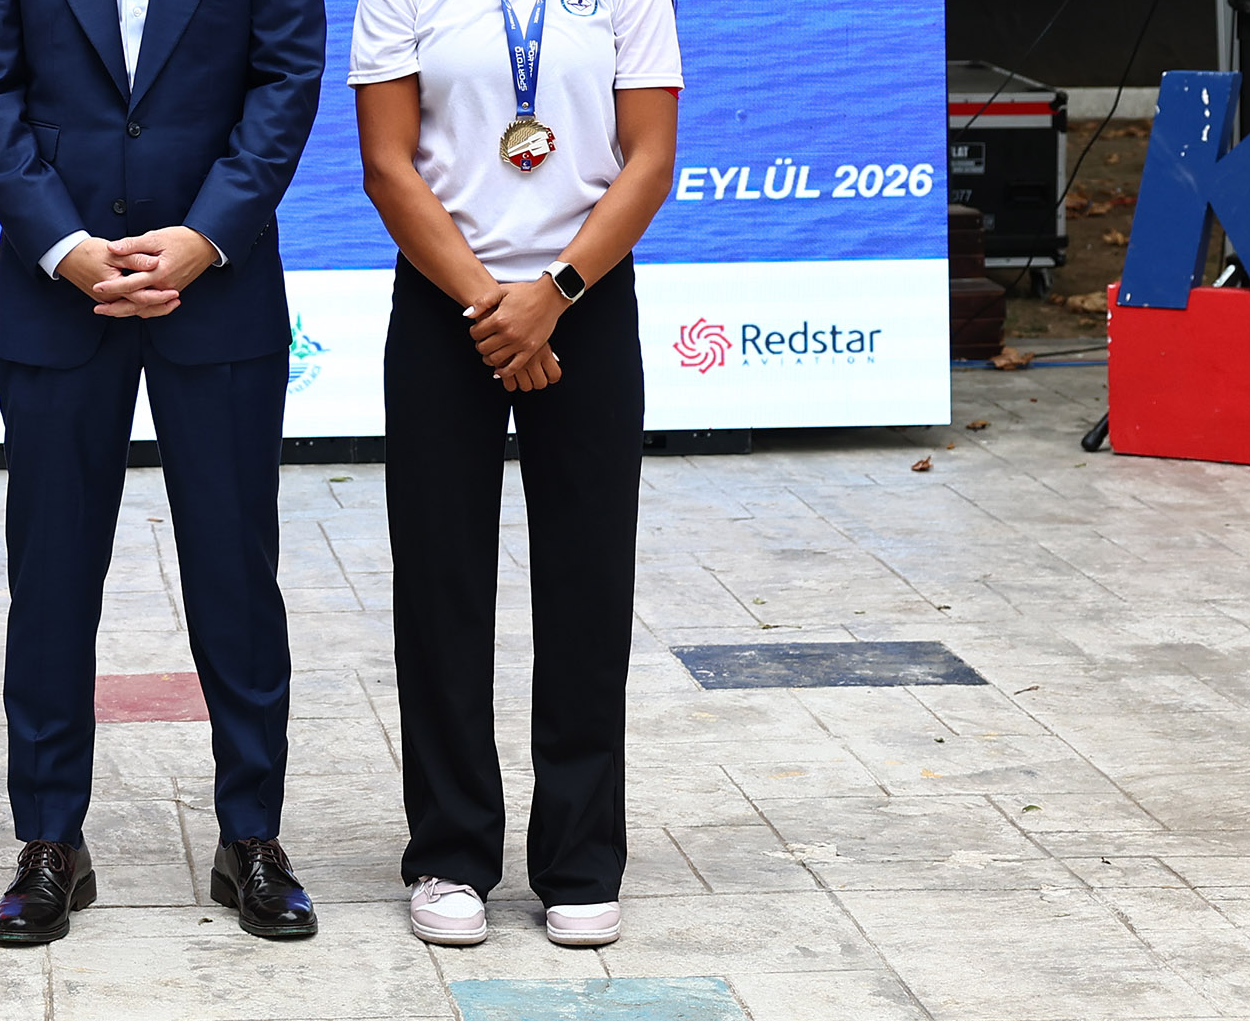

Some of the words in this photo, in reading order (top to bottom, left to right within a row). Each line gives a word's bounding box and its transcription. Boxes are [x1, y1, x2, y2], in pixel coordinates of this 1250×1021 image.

[676, 158, 821, 200] EYLÜL
[832, 163, 934, 198] 2026
[741, 321, 882, 356] Redstar
[741, 356, 876, 367] AVIATION
